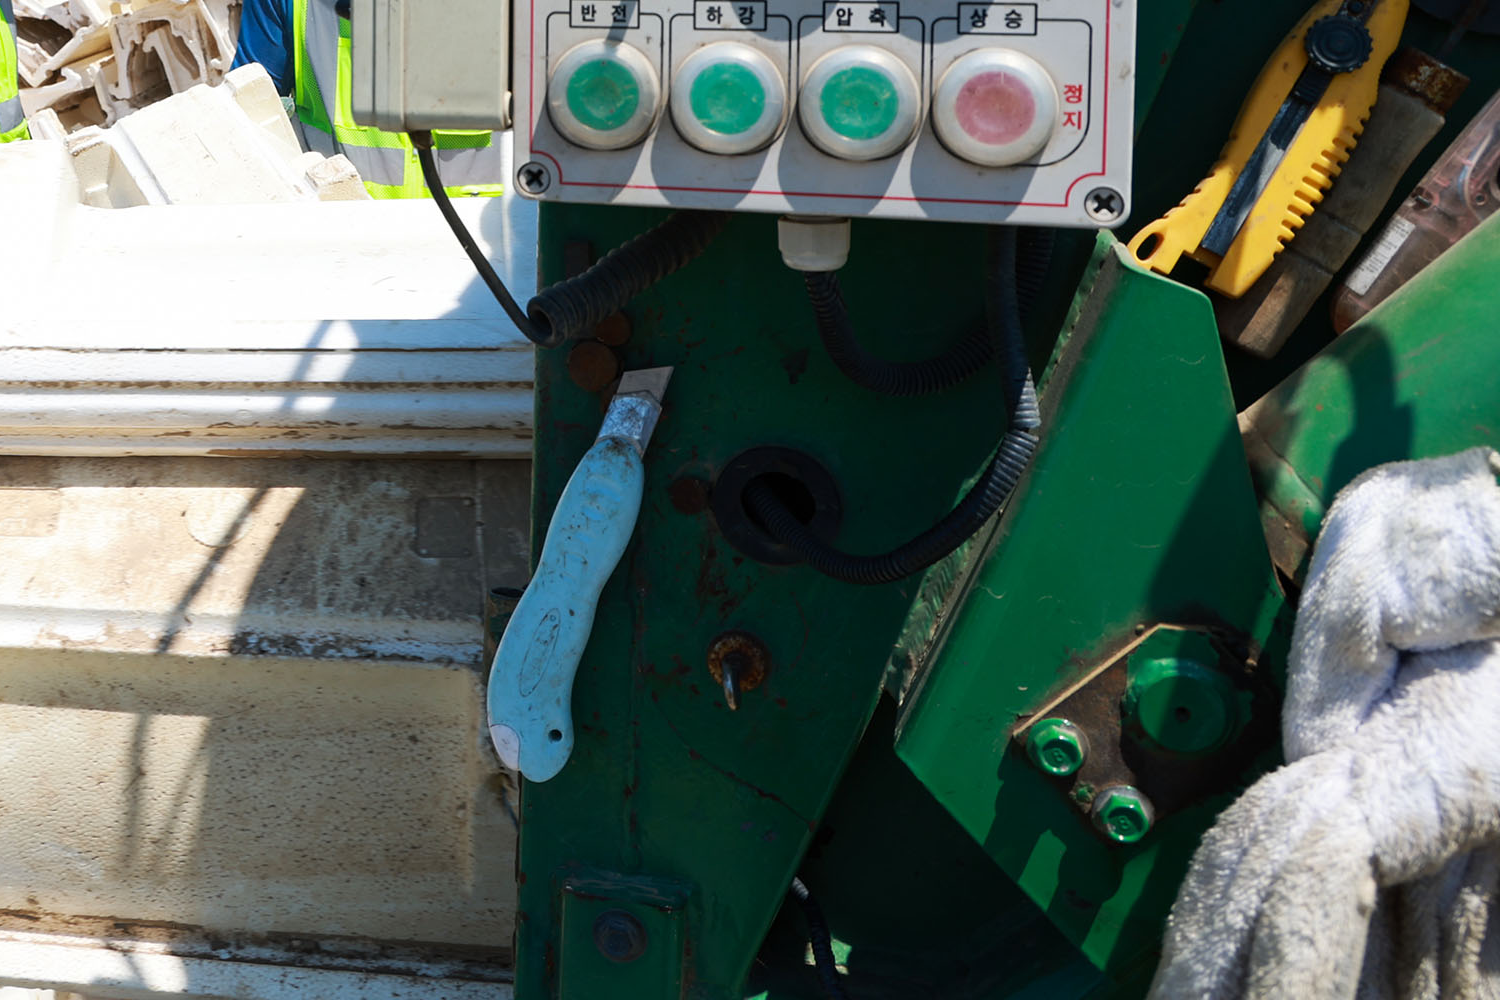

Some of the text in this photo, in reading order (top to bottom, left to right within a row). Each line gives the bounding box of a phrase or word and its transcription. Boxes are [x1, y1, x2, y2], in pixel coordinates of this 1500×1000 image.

[580, 3, 628, 23] 반전
[705, 5, 756, 26] 하강
[835, 7, 888, 28] 압축
[969, 8, 1024, 30] 상승
[1062, 83, 1083, 131] 정지
